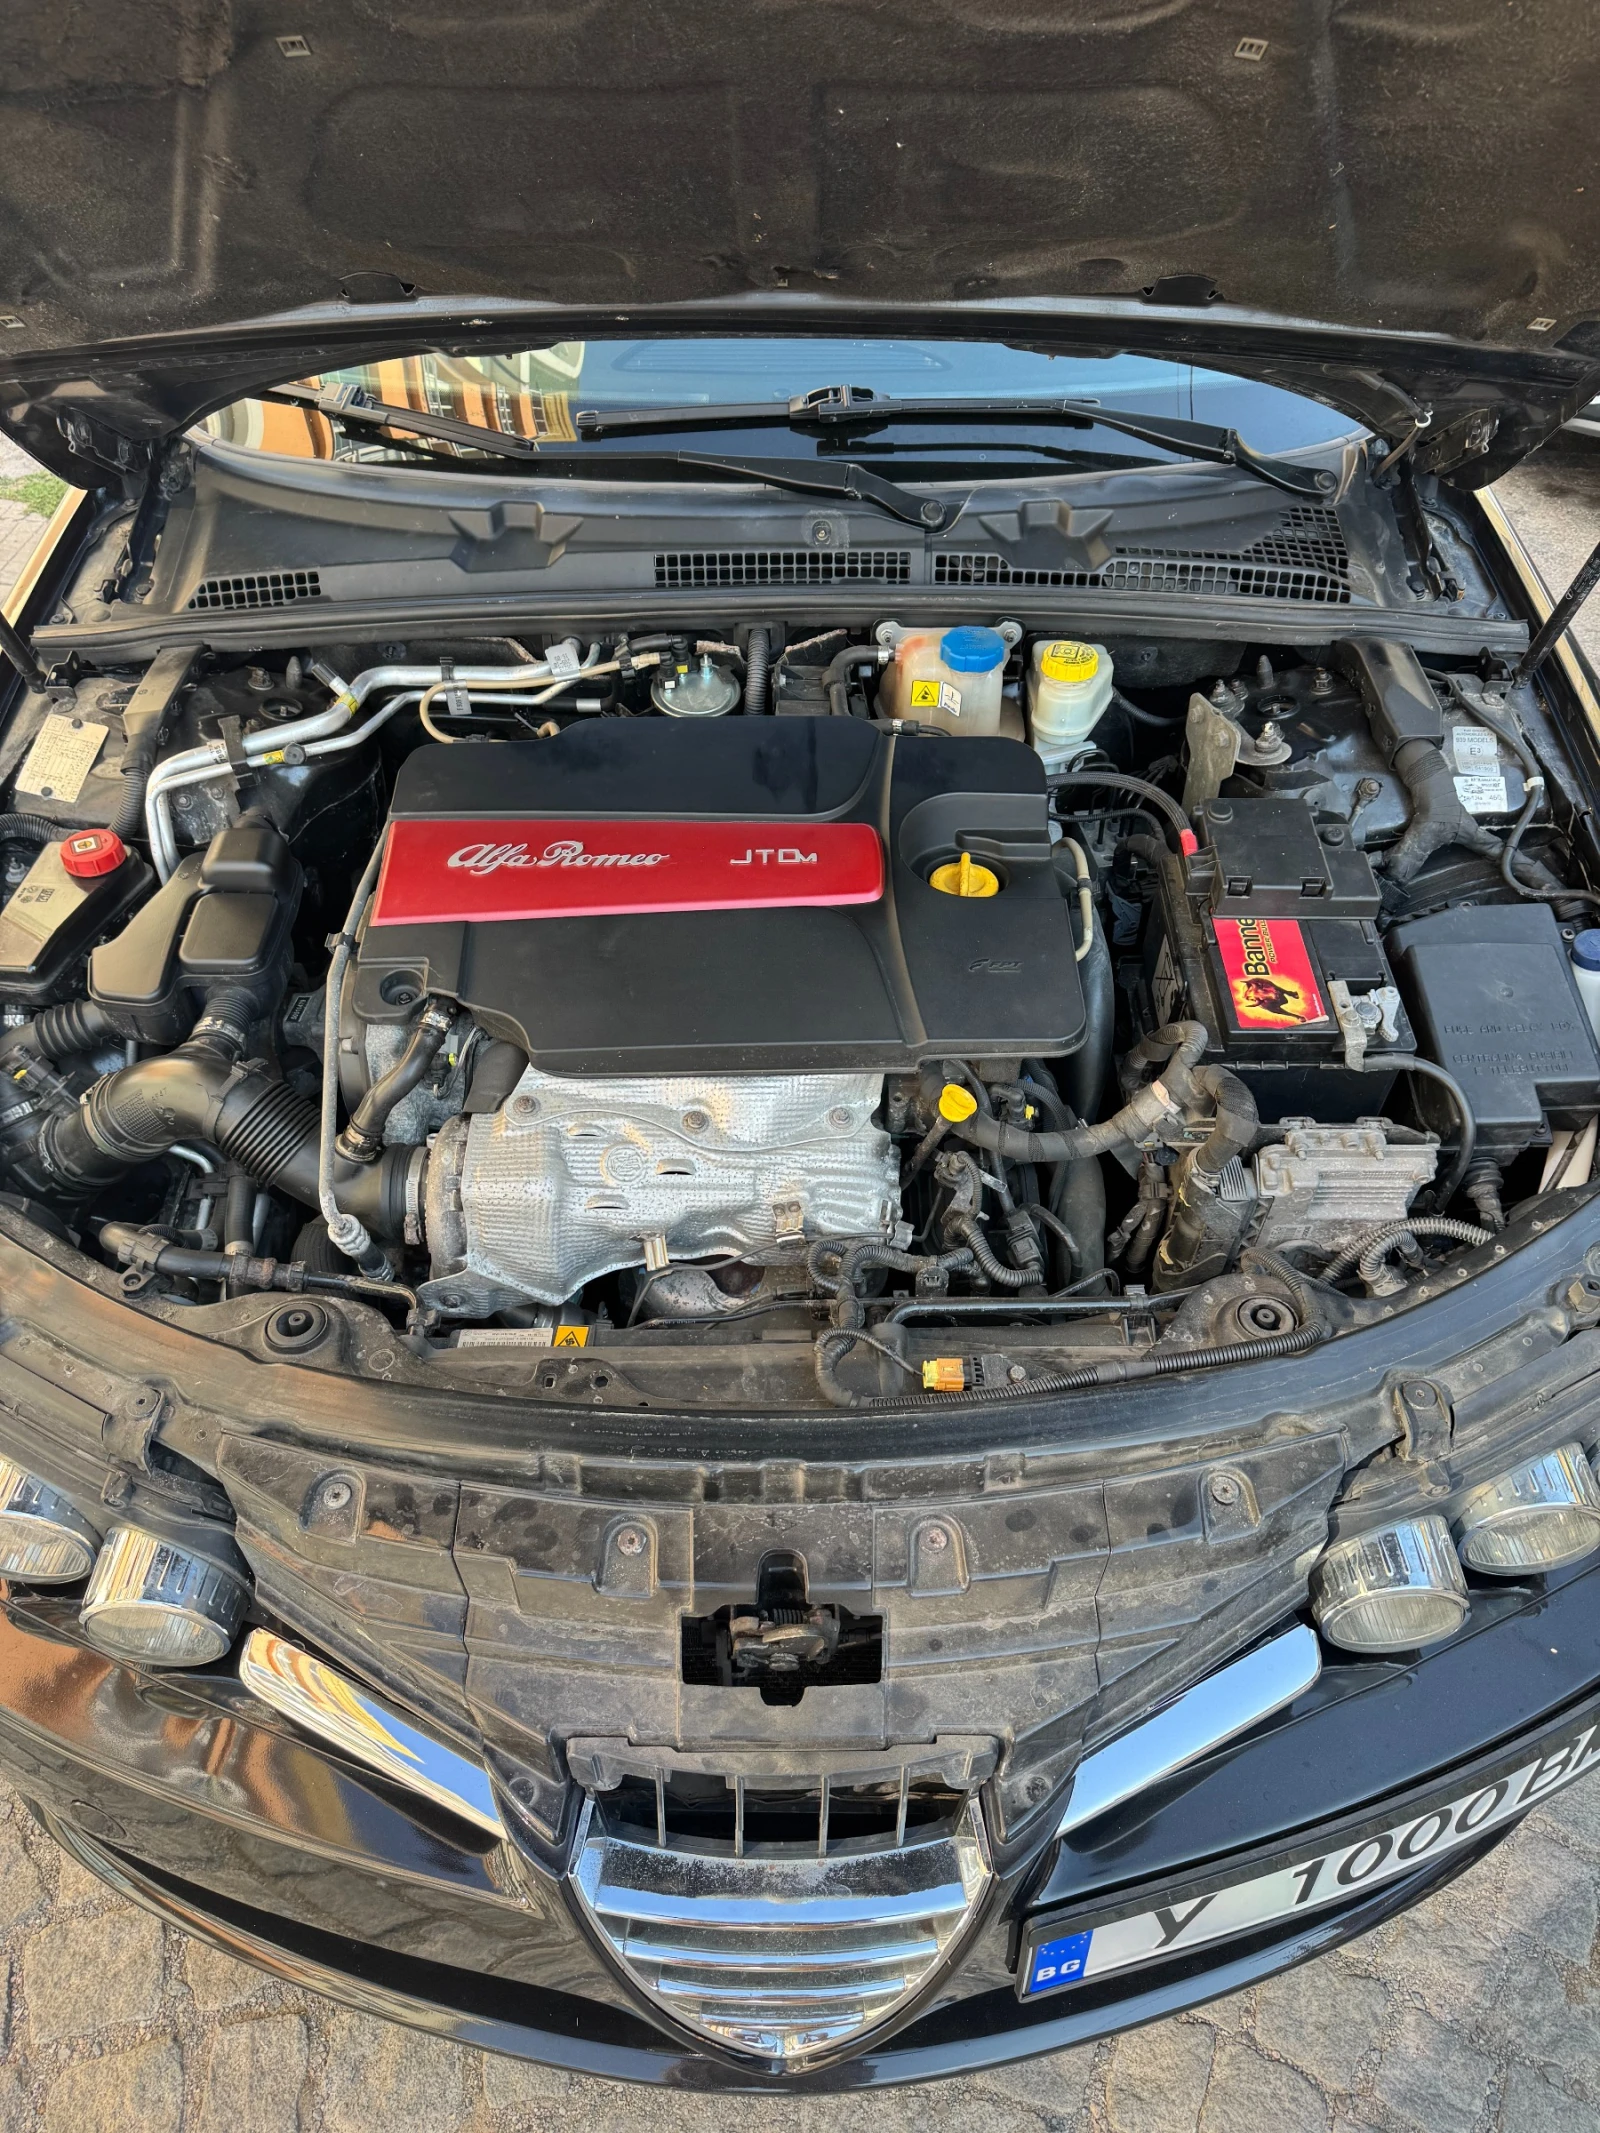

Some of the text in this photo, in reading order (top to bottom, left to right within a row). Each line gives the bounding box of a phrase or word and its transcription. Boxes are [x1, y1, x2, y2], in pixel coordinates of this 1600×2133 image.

[447, 840, 670, 875] Alfa Romeo
[1444, 1024, 1475, 1035] FUSE
[1293, 1779, 1510, 1906] 1000
[1036, 1959, 1081, 1982] BG
